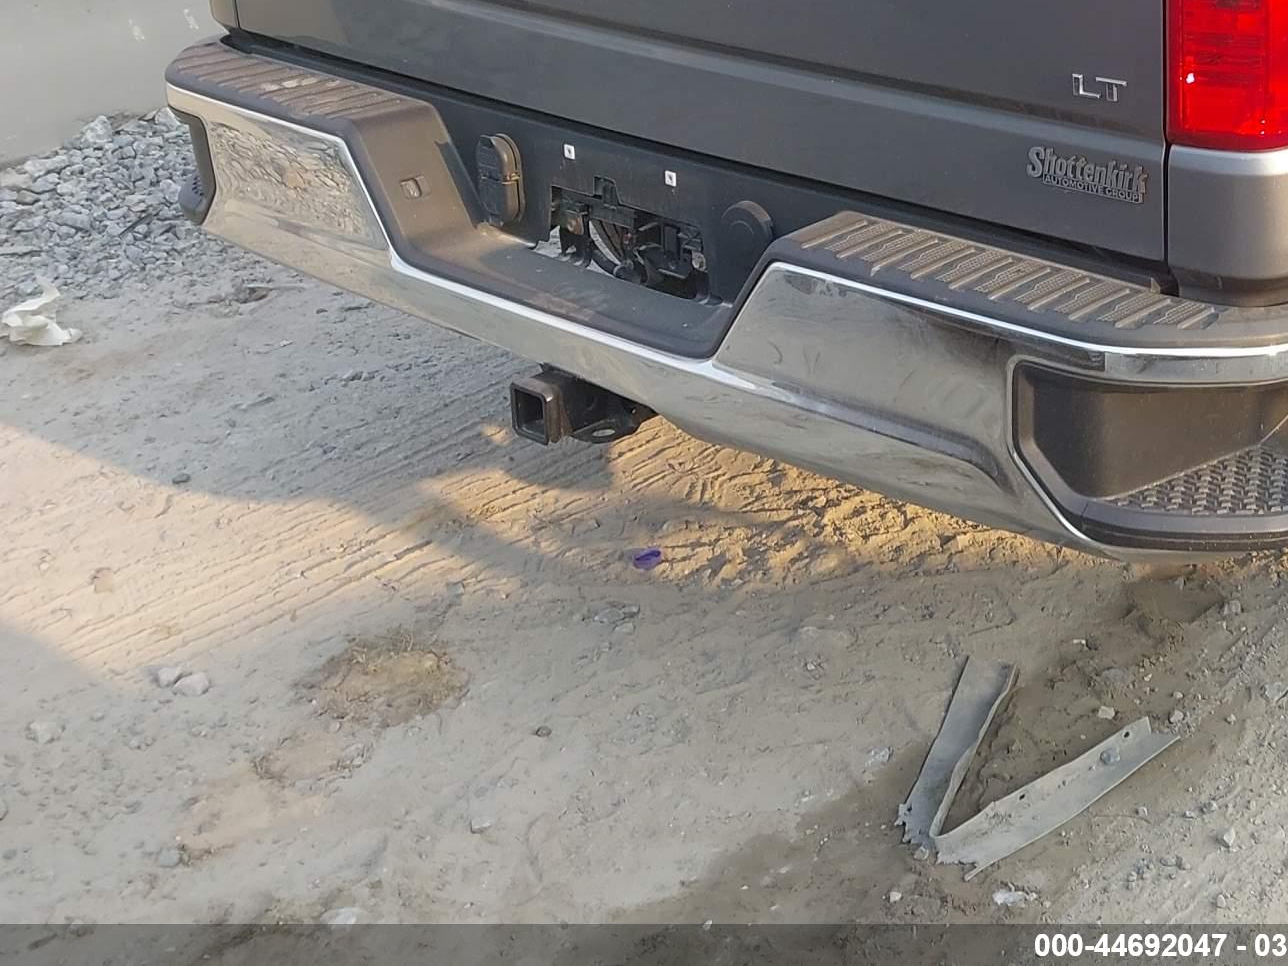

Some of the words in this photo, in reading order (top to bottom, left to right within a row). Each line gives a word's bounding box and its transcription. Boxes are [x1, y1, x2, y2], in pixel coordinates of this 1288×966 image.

[1072, 73, 1128, 102] LT
[1026, 145, 1149, 195] Shottenkirk
[1044, 174, 1104, 195] AUTOMOTIVE
[1105, 187, 1140, 202] GROUP
